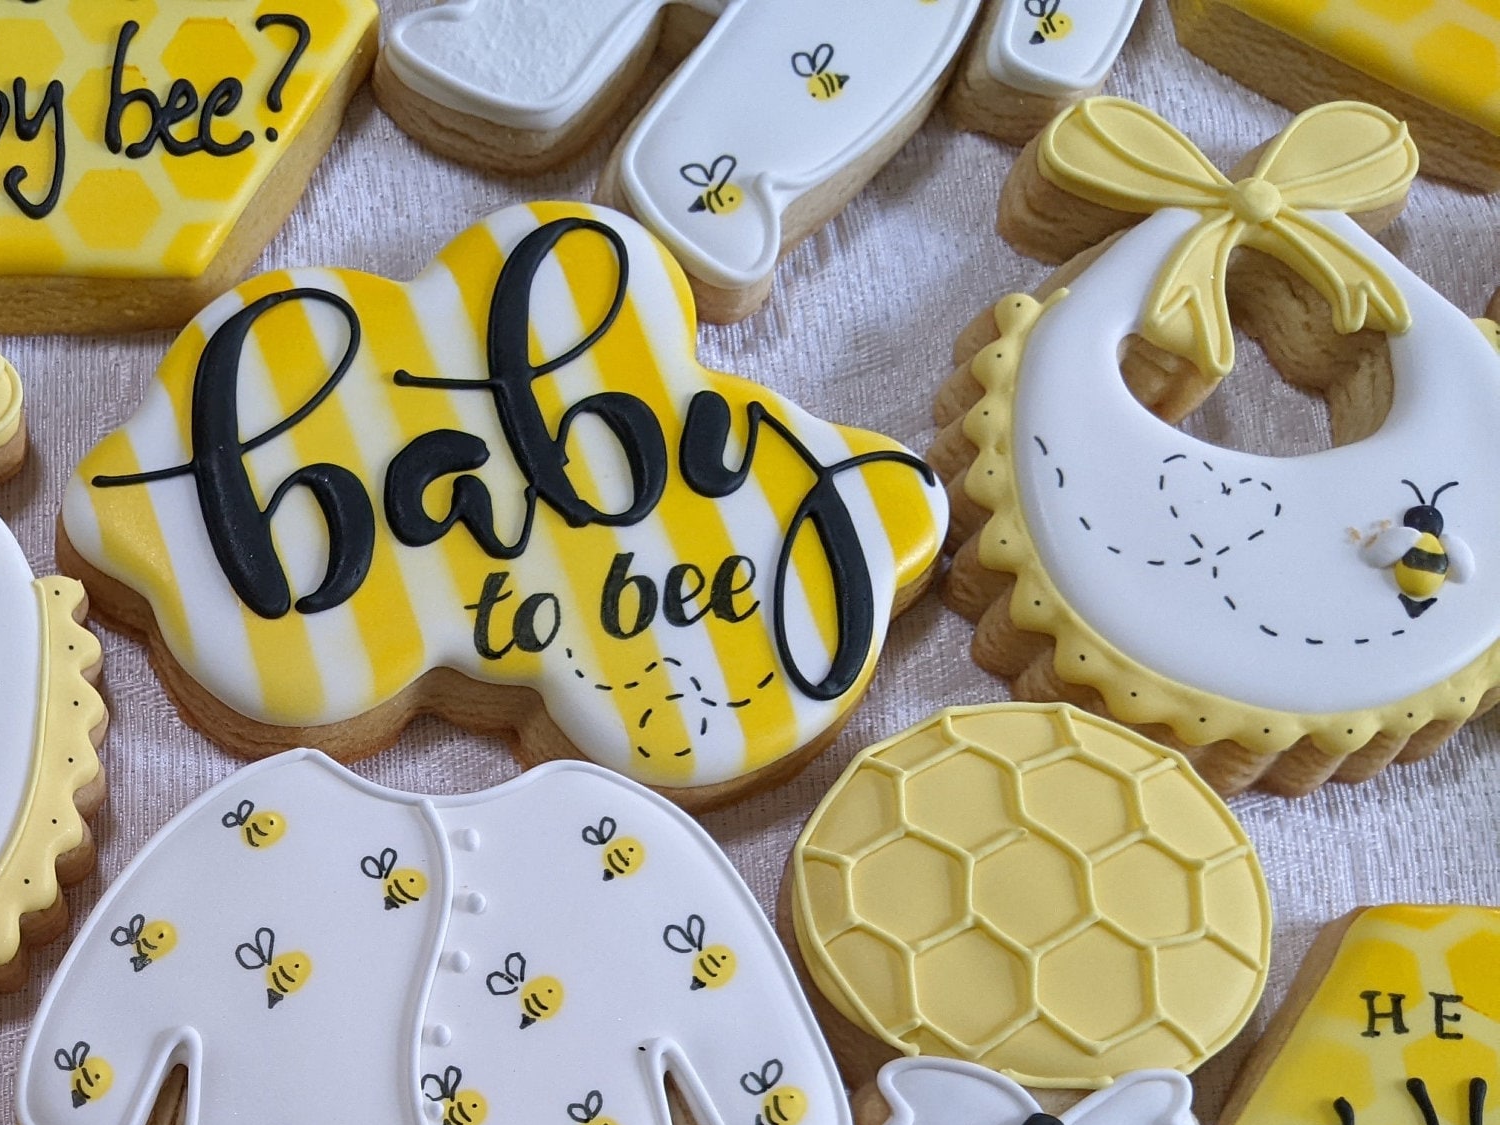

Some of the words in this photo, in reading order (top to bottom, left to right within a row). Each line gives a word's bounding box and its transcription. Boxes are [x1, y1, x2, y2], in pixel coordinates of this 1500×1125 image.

[104, 13, 311, 160] bee?
[91, 216, 937, 702] baby
[463, 570, 563, 661] to
[600, 551, 762, 640] bee
[1359, 989, 1464, 1040] HE
